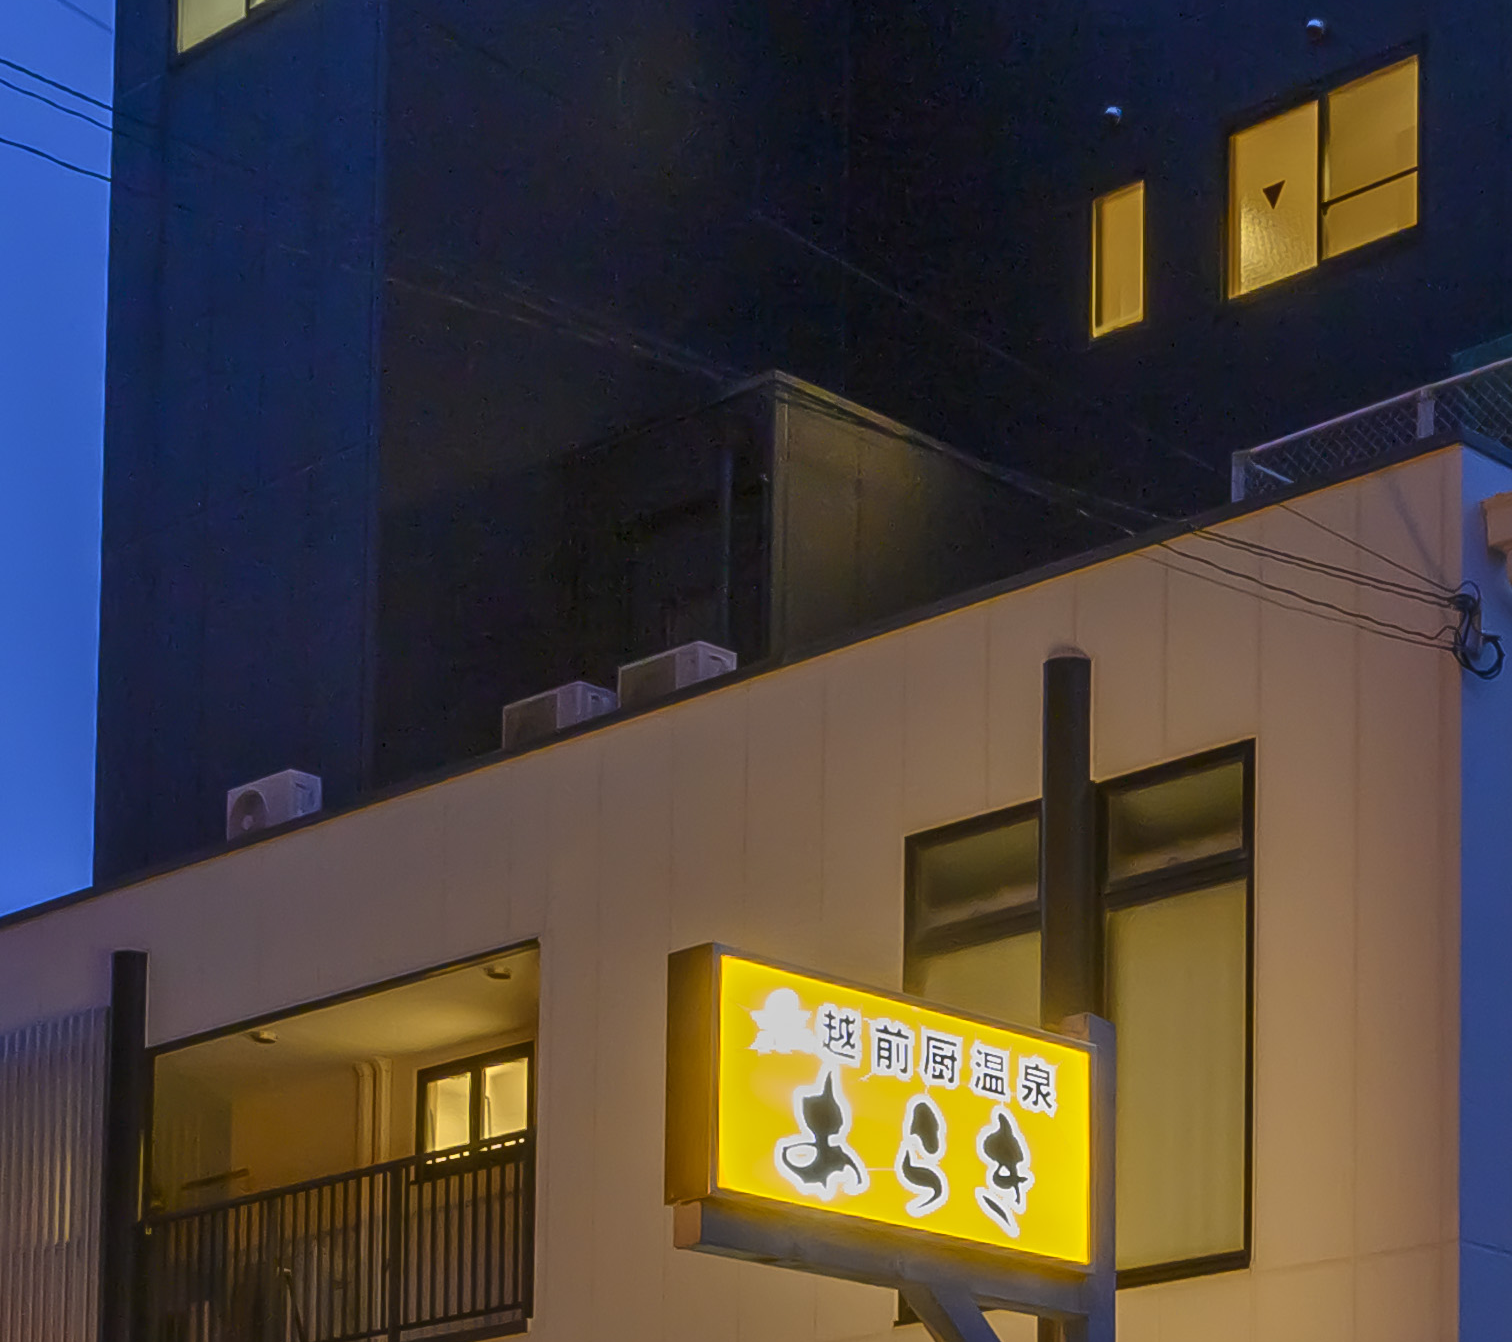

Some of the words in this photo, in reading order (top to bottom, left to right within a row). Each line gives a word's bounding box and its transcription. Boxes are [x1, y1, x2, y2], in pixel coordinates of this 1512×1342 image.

[822, 1010, 1053, 1109] 越前厨温泉
